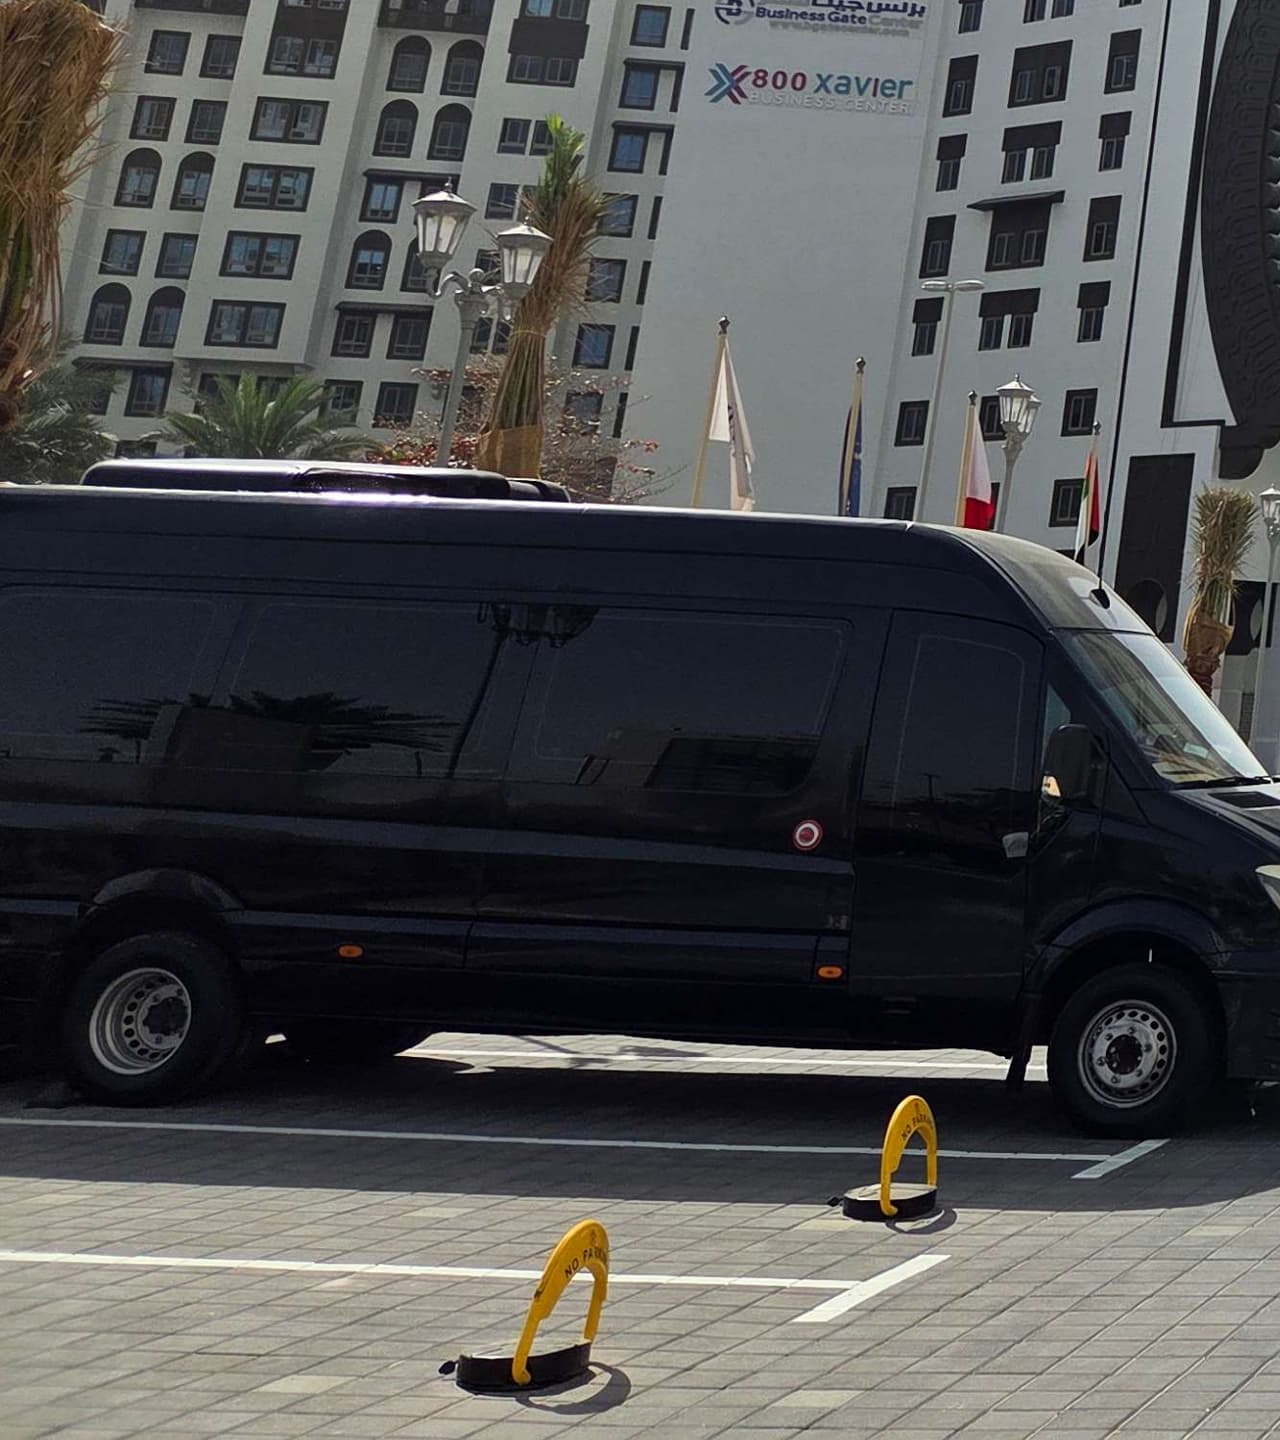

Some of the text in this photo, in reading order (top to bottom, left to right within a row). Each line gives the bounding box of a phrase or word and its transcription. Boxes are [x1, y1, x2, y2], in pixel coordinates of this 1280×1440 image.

[755, 6, 924, 29] Business Gate Center
[751, 68, 914, 99] 800 xavier
[751, 91, 911, 114] BUSINESS CENTER
[564, 1258, 579, 1279] NO
